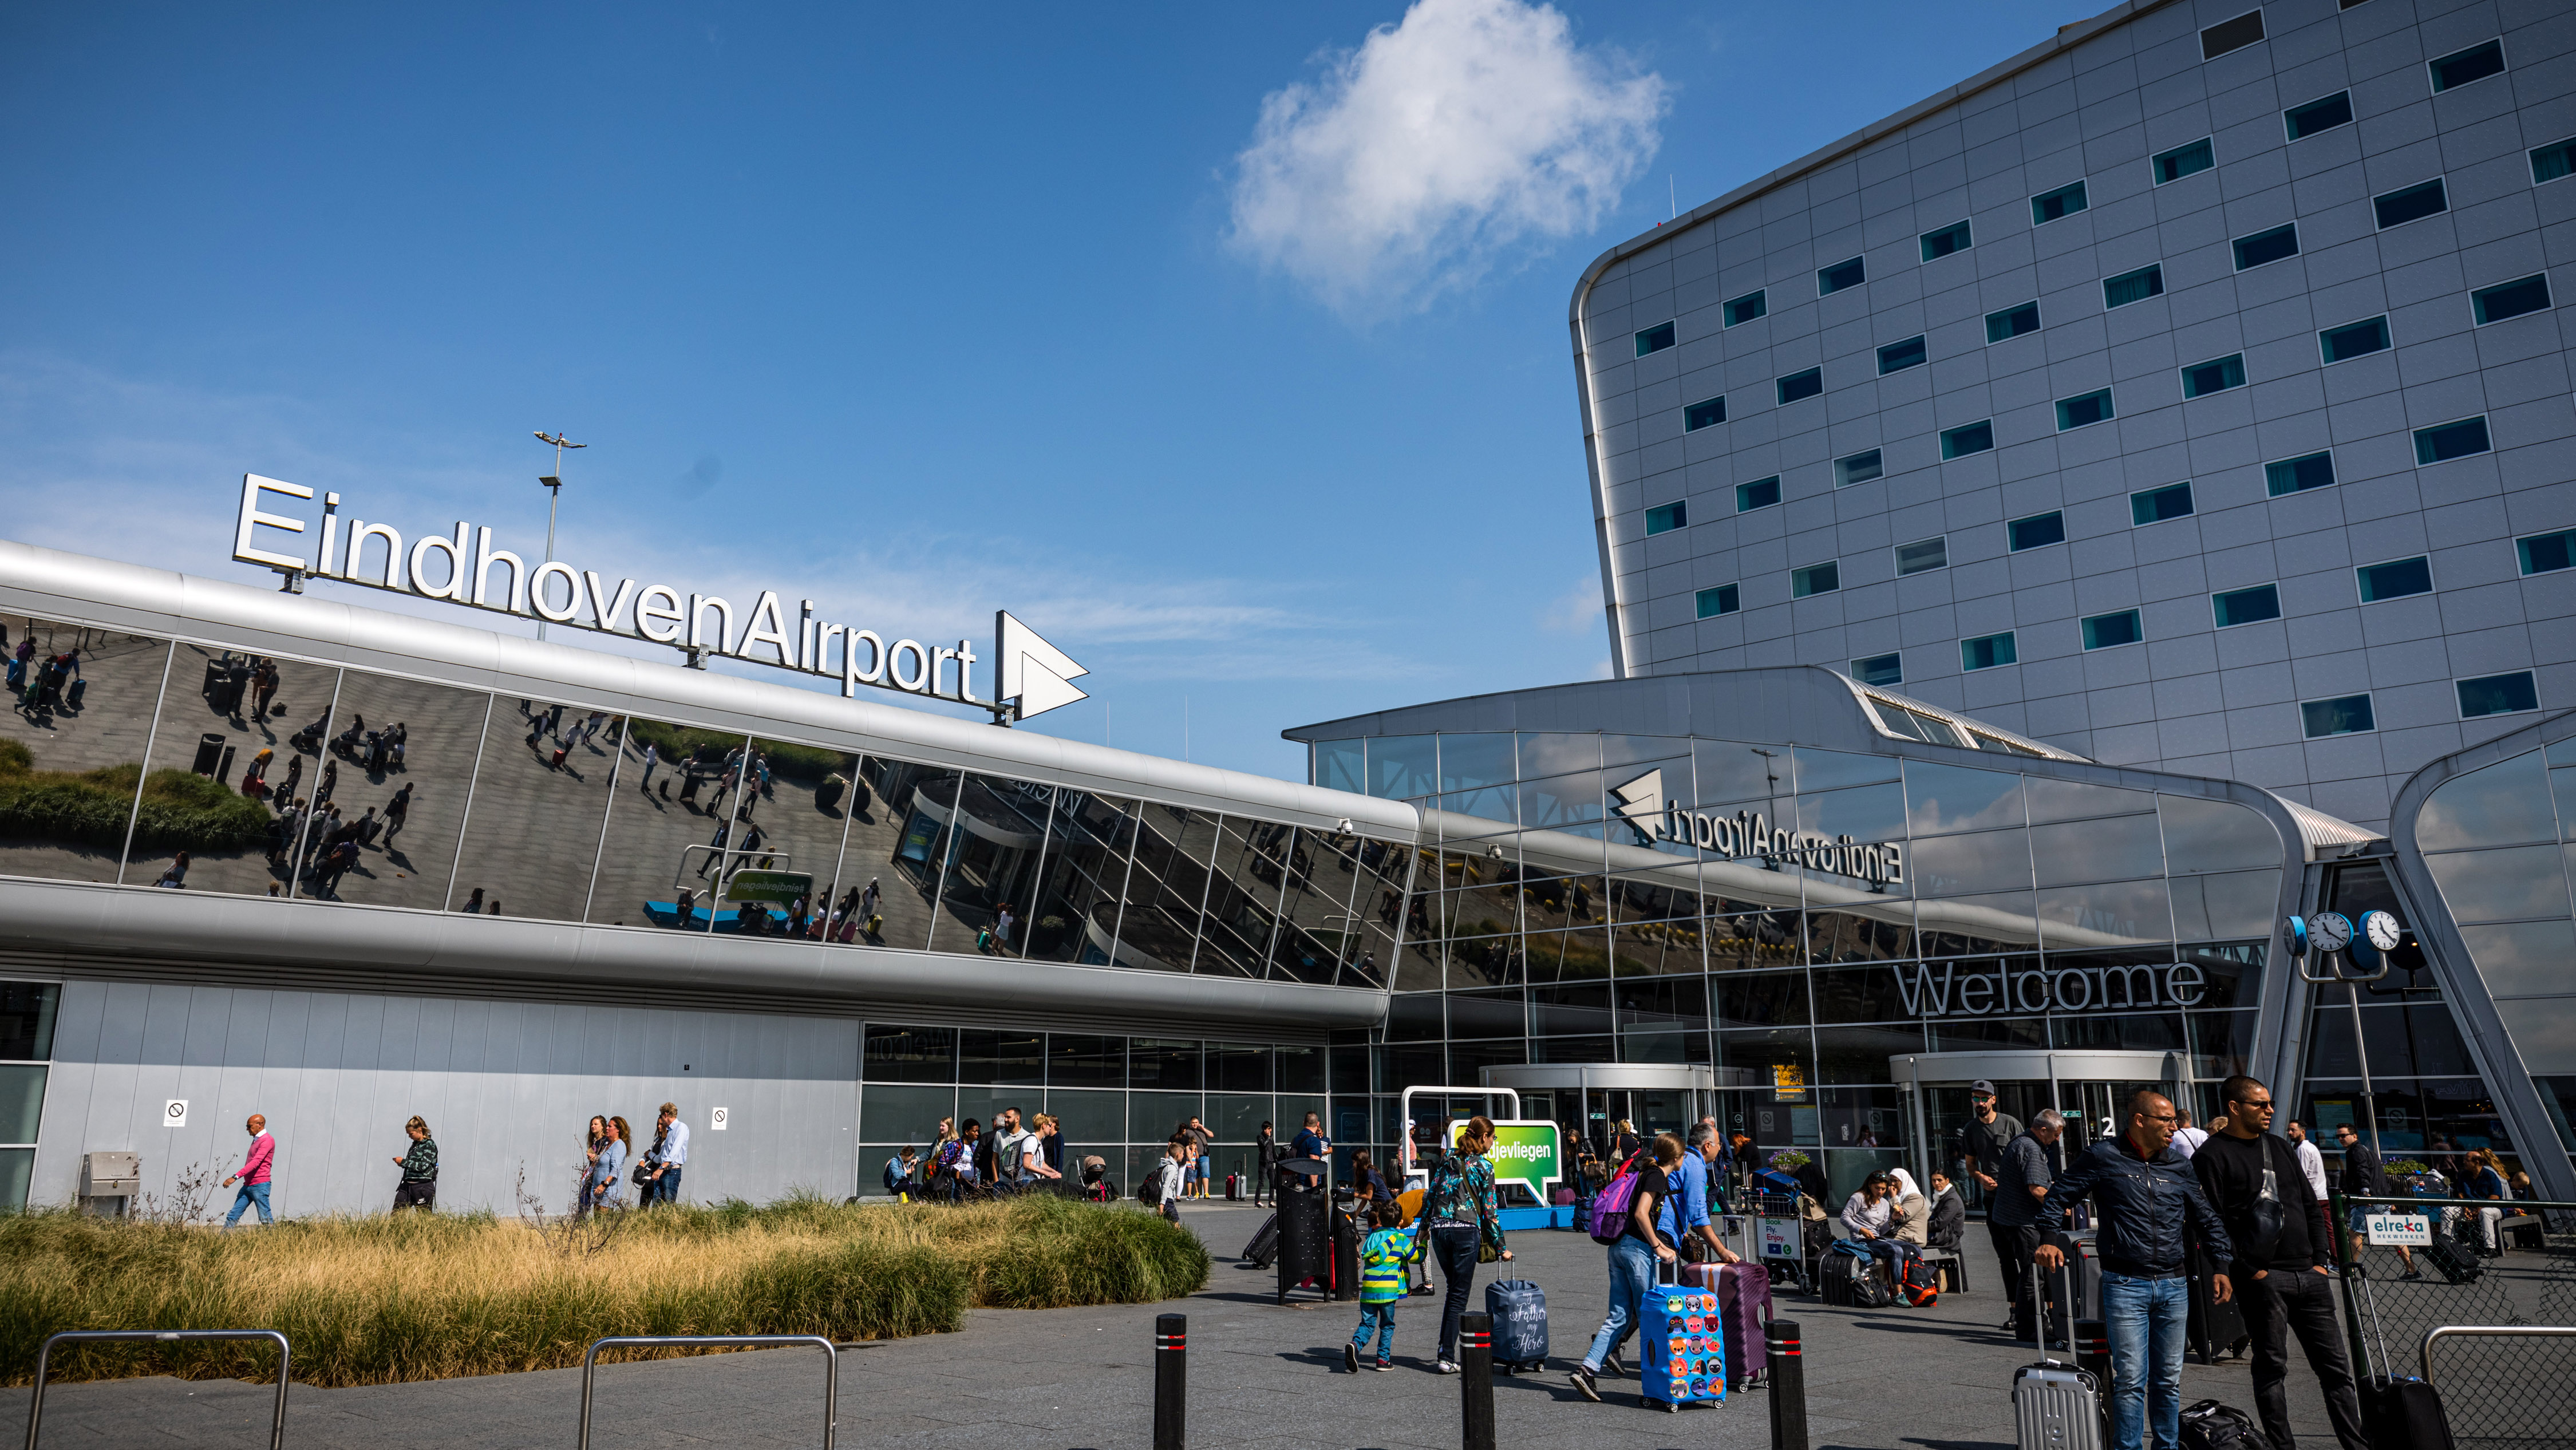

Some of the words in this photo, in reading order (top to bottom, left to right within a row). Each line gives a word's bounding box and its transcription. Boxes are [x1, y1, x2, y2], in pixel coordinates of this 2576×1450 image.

[232, 472, 976, 702] EindhovenAirport
[1893, 958, 2207, 1016] Welcome
[2101, 1117, 2116, 1136] 2
[1485, 1141, 1551, 1162] djevliegen
[1765, 1218, 1783, 1226] Book.
[1766, 1226, 1777, 1234] Fly.
[2374, 1216, 2424, 1232] elreka
[1767, 1234, 1785, 1243] Enjoy.
[1523, 1293, 1533, 1304] my
[1509, 1302, 1547, 1322] Father
[1527, 1323, 1538, 1338] my
[1512, 1333, 1544, 1353] Hero
